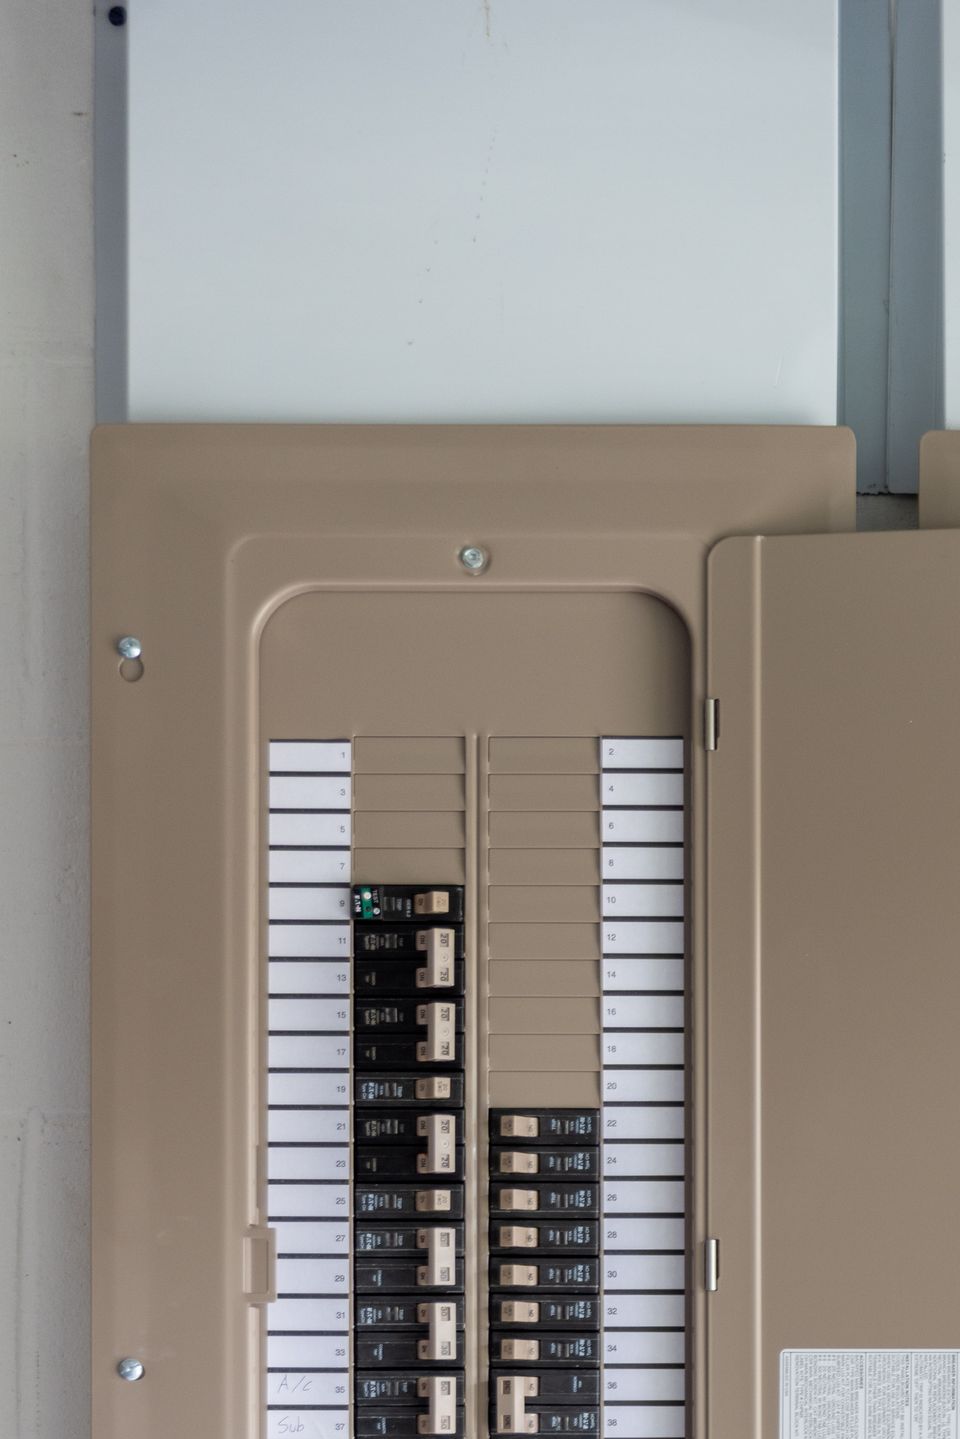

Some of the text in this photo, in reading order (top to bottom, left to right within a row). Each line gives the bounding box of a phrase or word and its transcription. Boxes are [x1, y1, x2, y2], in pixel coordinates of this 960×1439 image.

[607, 896, 617, 904] 10
[607, 933, 617, 941] 12
[336, 974, 347, 982] 13
[336, 1011, 346, 1019] 15
[607, 1008, 617, 1016] 16
[336, 1048, 347, 1056] 17
[607, 1045, 617, 1053] 18
[336, 1085, 346, 1093] 19
[606, 1082, 617, 1090] 20
[336, 1122, 346, 1131] 21
[606, 1119, 617, 1127] 22
[335, 1160, 346, 1168] 23
[607, 1156, 617, 1164] 24
[335, 1197, 346, 1205] 25
[607, 1194, 617, 1202] 26
[335, 1234, 346, 1242] 27
[607, 1231, 617, 1239] 28
[334, 1274, 345, 1283] 29
[607, 1270, 618, 1279] 30
[336, 1311, 345, 1320] 31
[607, 1307, 618, 1316] 32
[335, 1348, 346, 1357] 33
[278, 1374, 313, 1393] A/C
[607, 1381, 618, 1390] 36
[335, 1385, 346, 1394] 35
[278, 1416, 305, 1435] Sub
[607, 1418, 618, 1427] 38
[335, 1423, 346, 1431] 37
